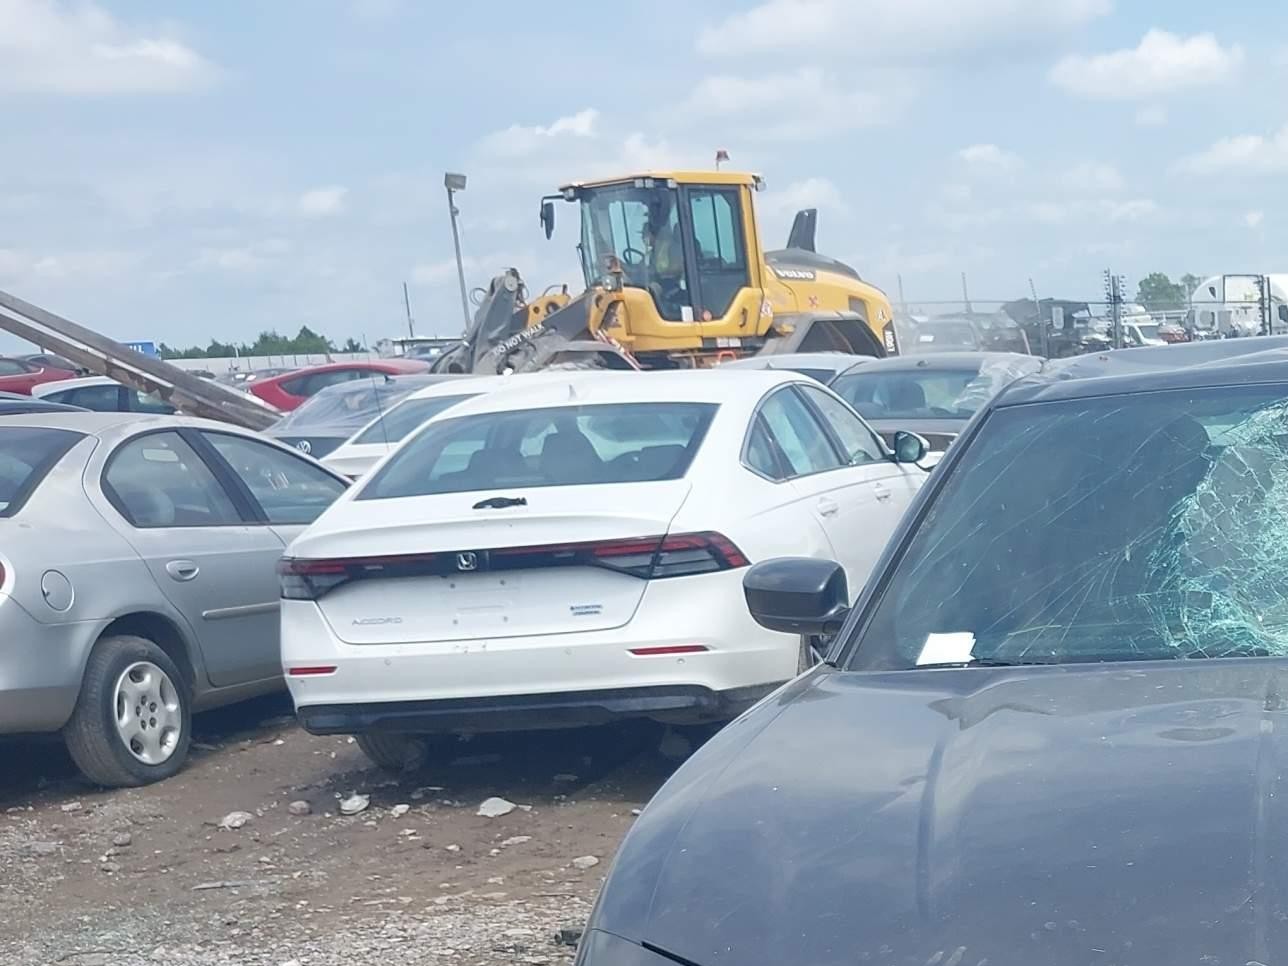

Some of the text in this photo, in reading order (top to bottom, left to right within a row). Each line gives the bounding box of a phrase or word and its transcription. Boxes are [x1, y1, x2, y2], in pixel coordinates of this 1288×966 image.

[777, 269, 815, 280] VOLVO
[503, 333, 522, 350] NOT
[521, 323, 544, 339] WALK
